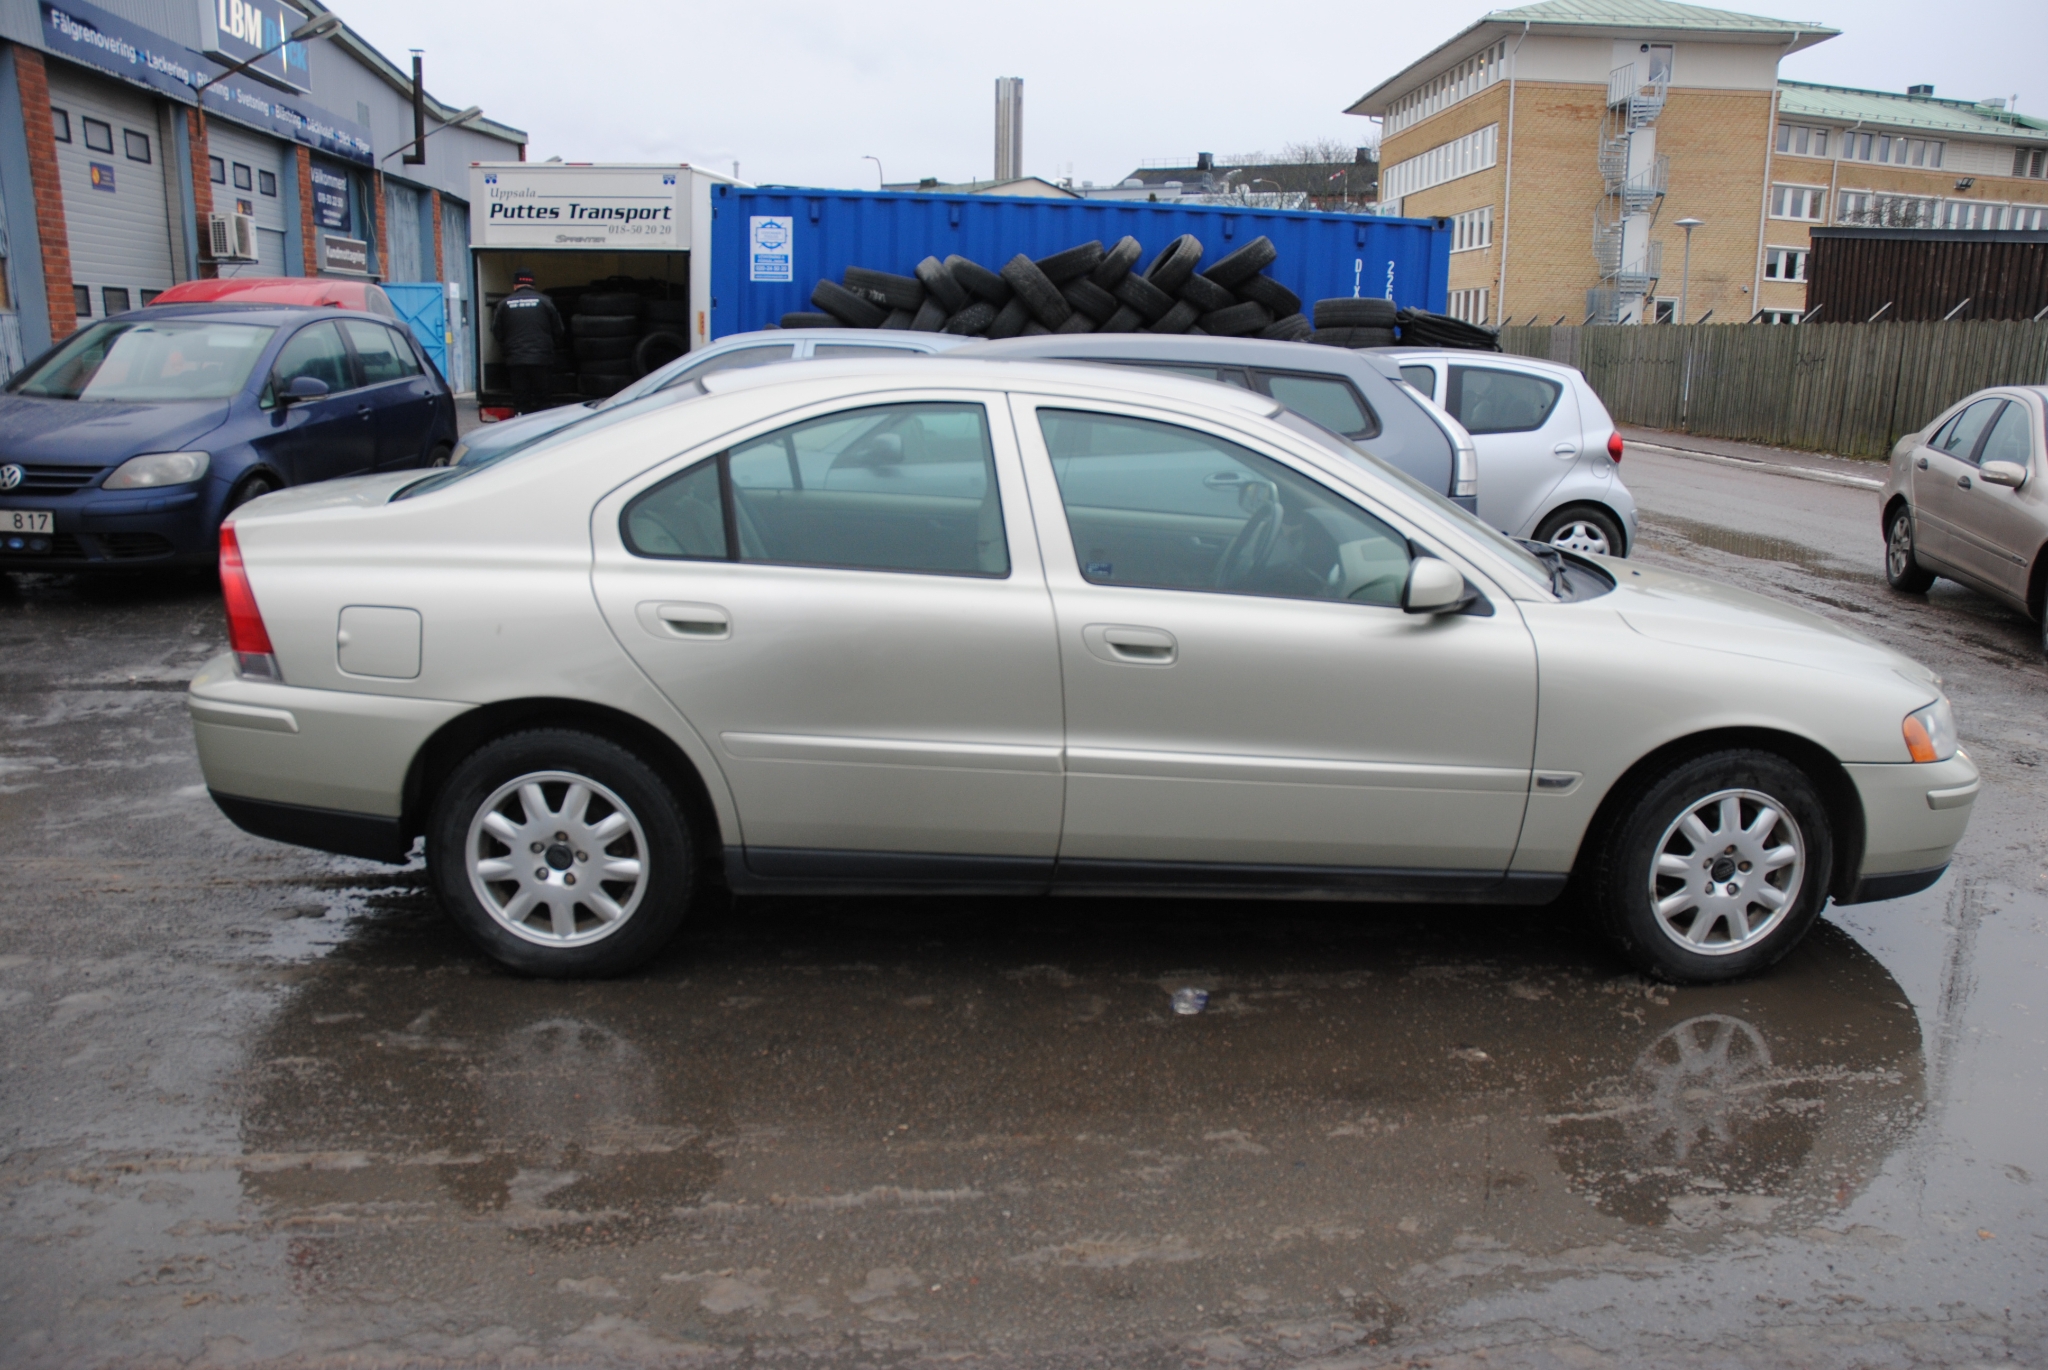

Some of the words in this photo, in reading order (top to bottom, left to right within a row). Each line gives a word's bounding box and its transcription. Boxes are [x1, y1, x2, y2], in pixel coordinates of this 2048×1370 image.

[219, 0, 263, 49] LBM
[51, 8, 138, 64] Fälgrenovering
[146, 49, 190, 85] Lackering
[237, 88, 269, 117] Svetsning
[490, 187, 536, 201] Uppsala
[489, 203, 560, 219] Puttes
[568, 203, 672, 223] Transport
[608, 224, 642, 234] 018-50
[645, 224, 657, 234] 20
[659, 224, 672, 234] 20
[13, 513, 48, 530] 817
